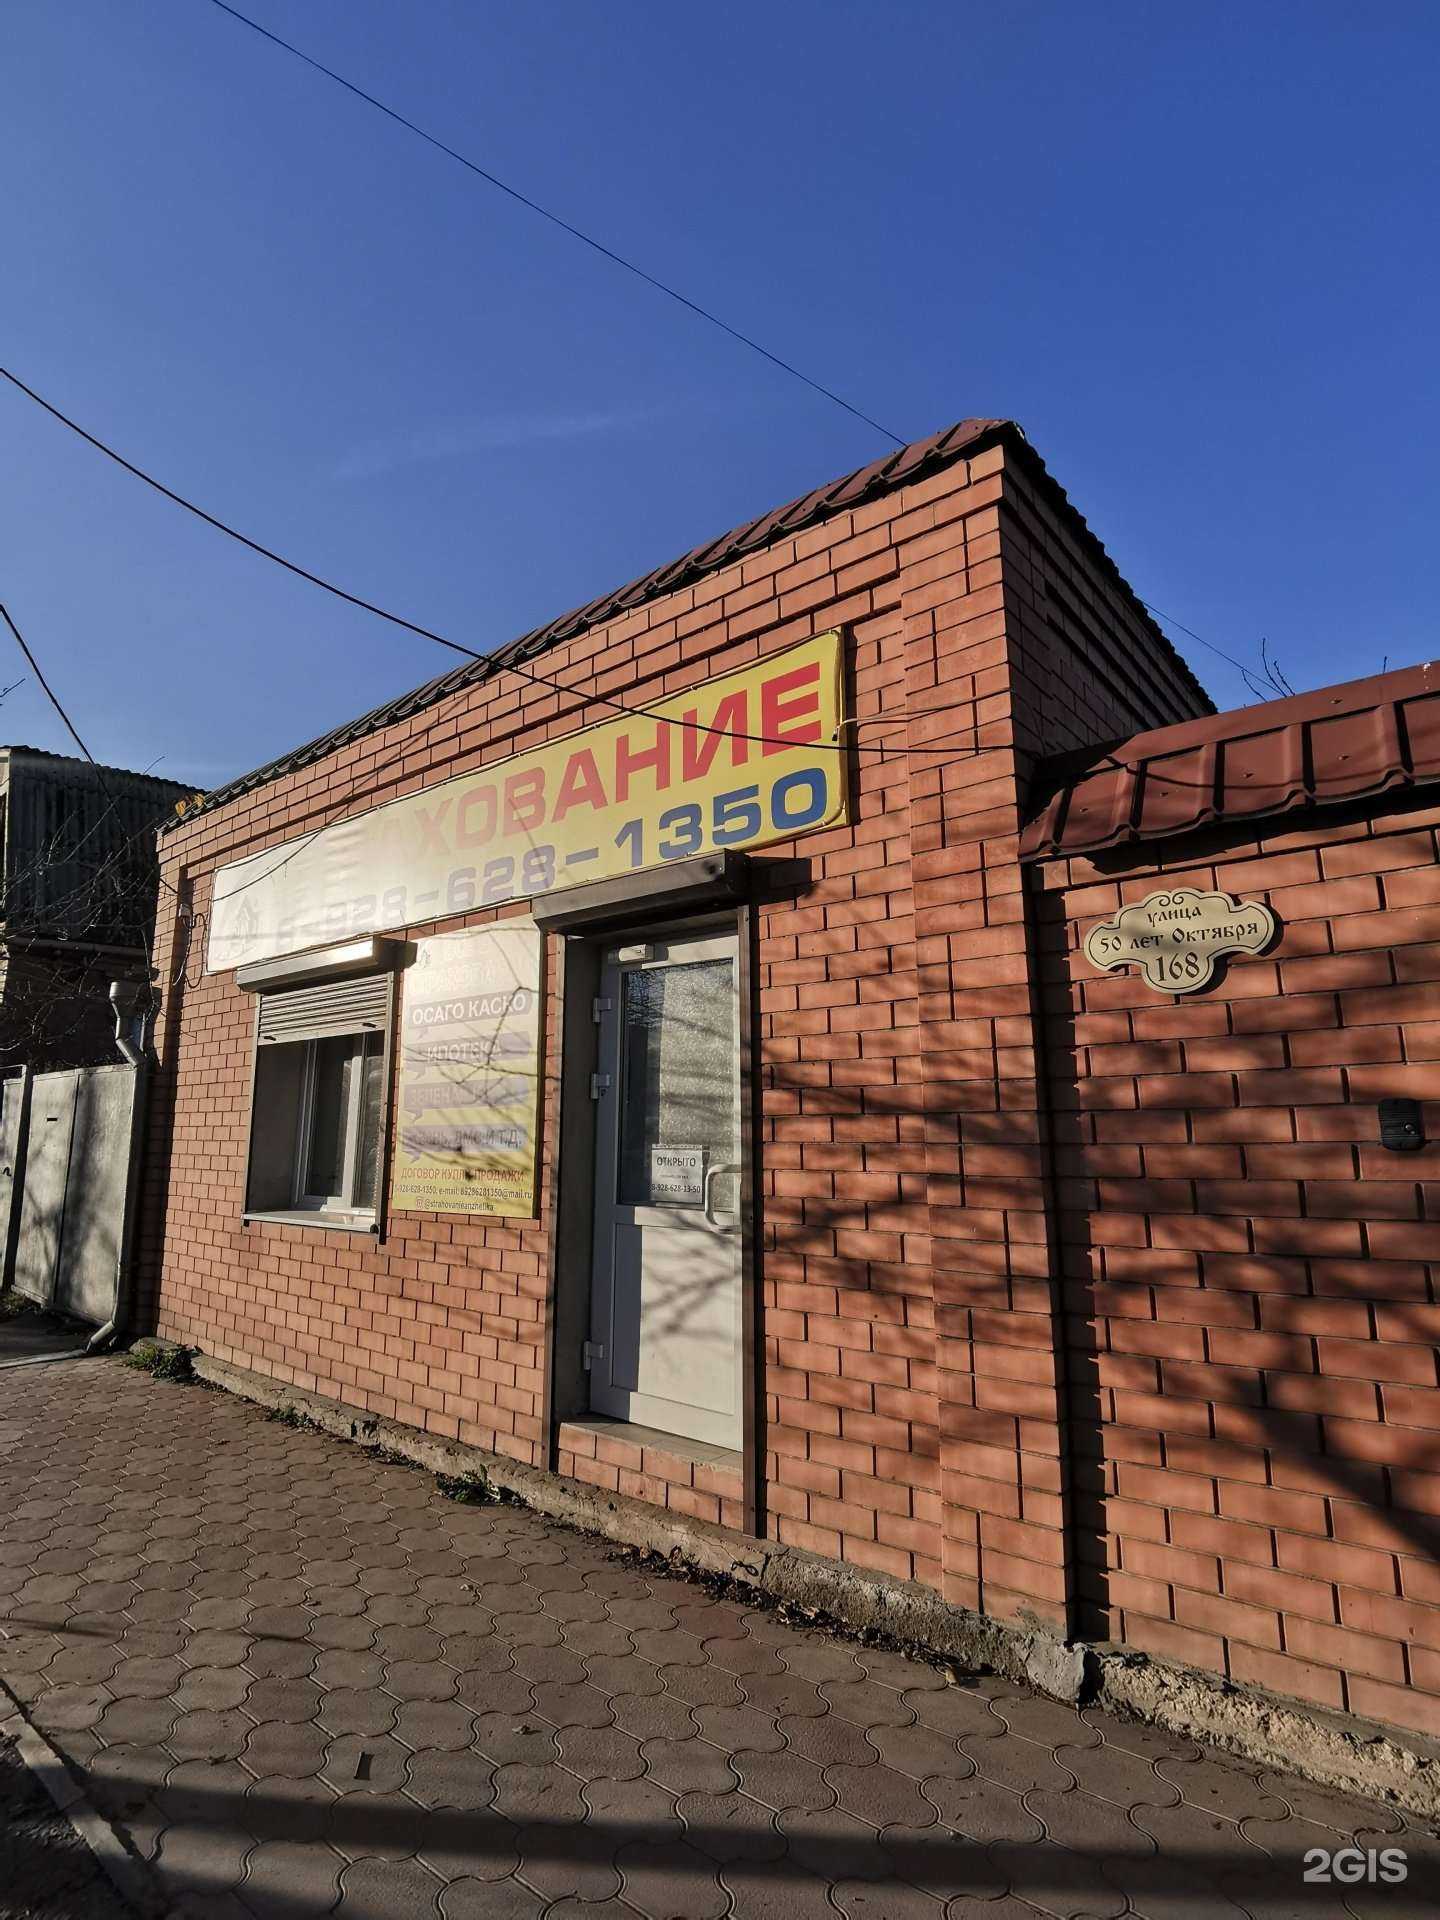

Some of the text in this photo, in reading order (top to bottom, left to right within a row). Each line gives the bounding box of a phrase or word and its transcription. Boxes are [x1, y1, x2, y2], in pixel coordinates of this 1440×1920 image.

[1147, 907, 1202, 928] улица
[1100, 922, 1258, 954] 50 лет Октября
[1155, 951, 1200, 982] 168
[412, 993, 526, 1025] ОСАГО КАСКО
[427, 1039, 502, 1064] ИПОТЕКА
[400, 1167, 439, 1180] ДОГОВОР
[656, 1156, 697, 1168] ОТКРЫТО
